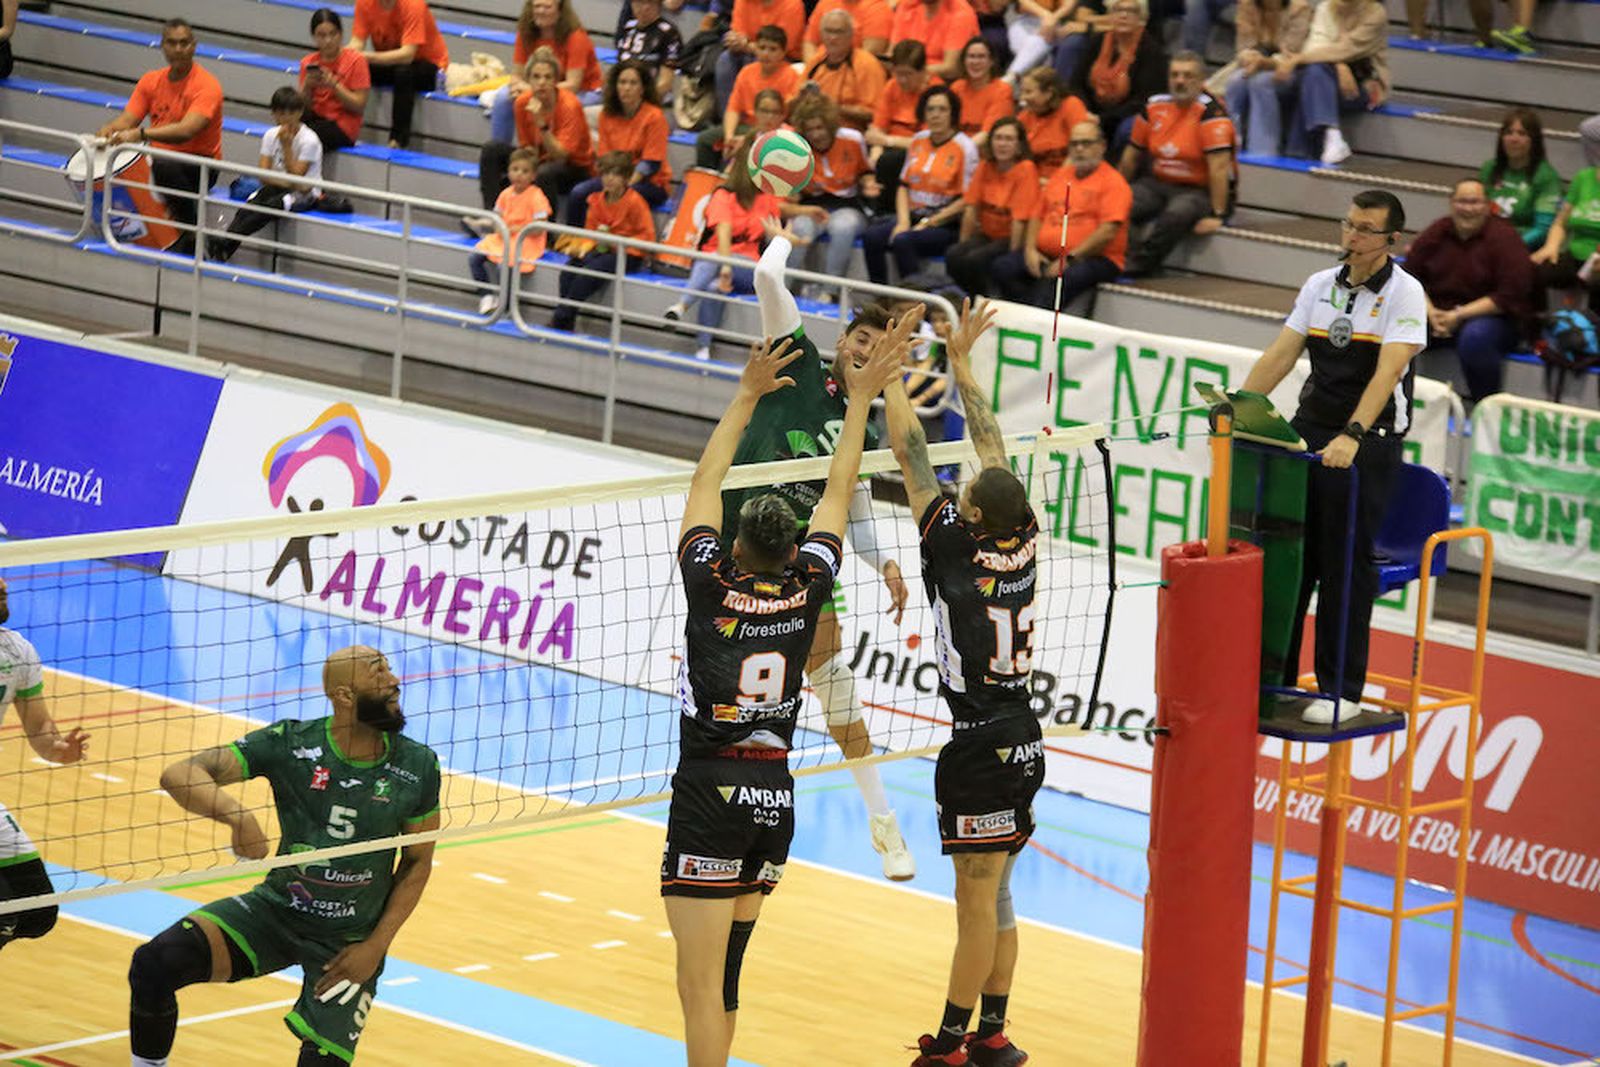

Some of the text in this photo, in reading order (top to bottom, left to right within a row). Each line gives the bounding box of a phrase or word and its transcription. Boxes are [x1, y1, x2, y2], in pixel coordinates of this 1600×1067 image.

[991, 328, 1228, 450] PEÑA
[0, 456, 104, 506] ALMERÍA
[541, 528, 602, 579] DE
[318, 549, 576, 660] ALMERÍA
[739, 618, 805, 639] forestalia
[985, 605, 1034, 675] 13
[736, 651, 787, 708] 9
[1029, 669, 1160, 748] Banc
[326, 804, 357, 839] 5
[1366, 809, 1482, 862] VOEIBOL
